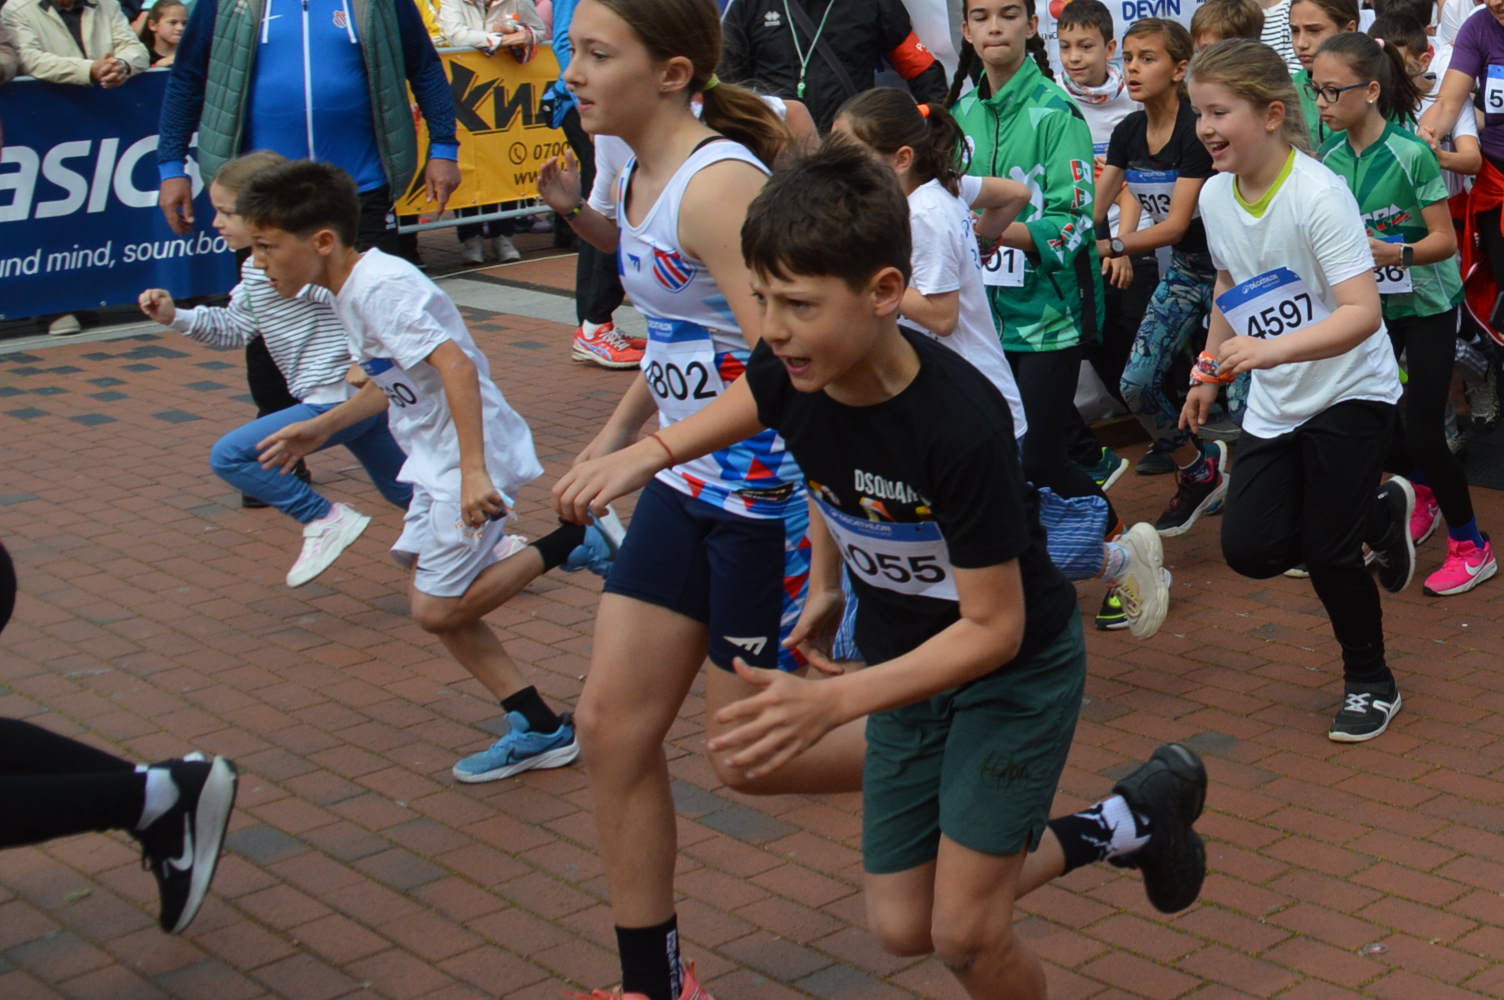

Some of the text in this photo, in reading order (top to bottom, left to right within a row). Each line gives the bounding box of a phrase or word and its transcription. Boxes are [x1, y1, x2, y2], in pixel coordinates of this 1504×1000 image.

[1137, 193, 1172, 214] 513
[46, 239, 117, 272] mind,
[1247, 292, 1313, 339] 4597
[846, 543, 946, 584] 055
